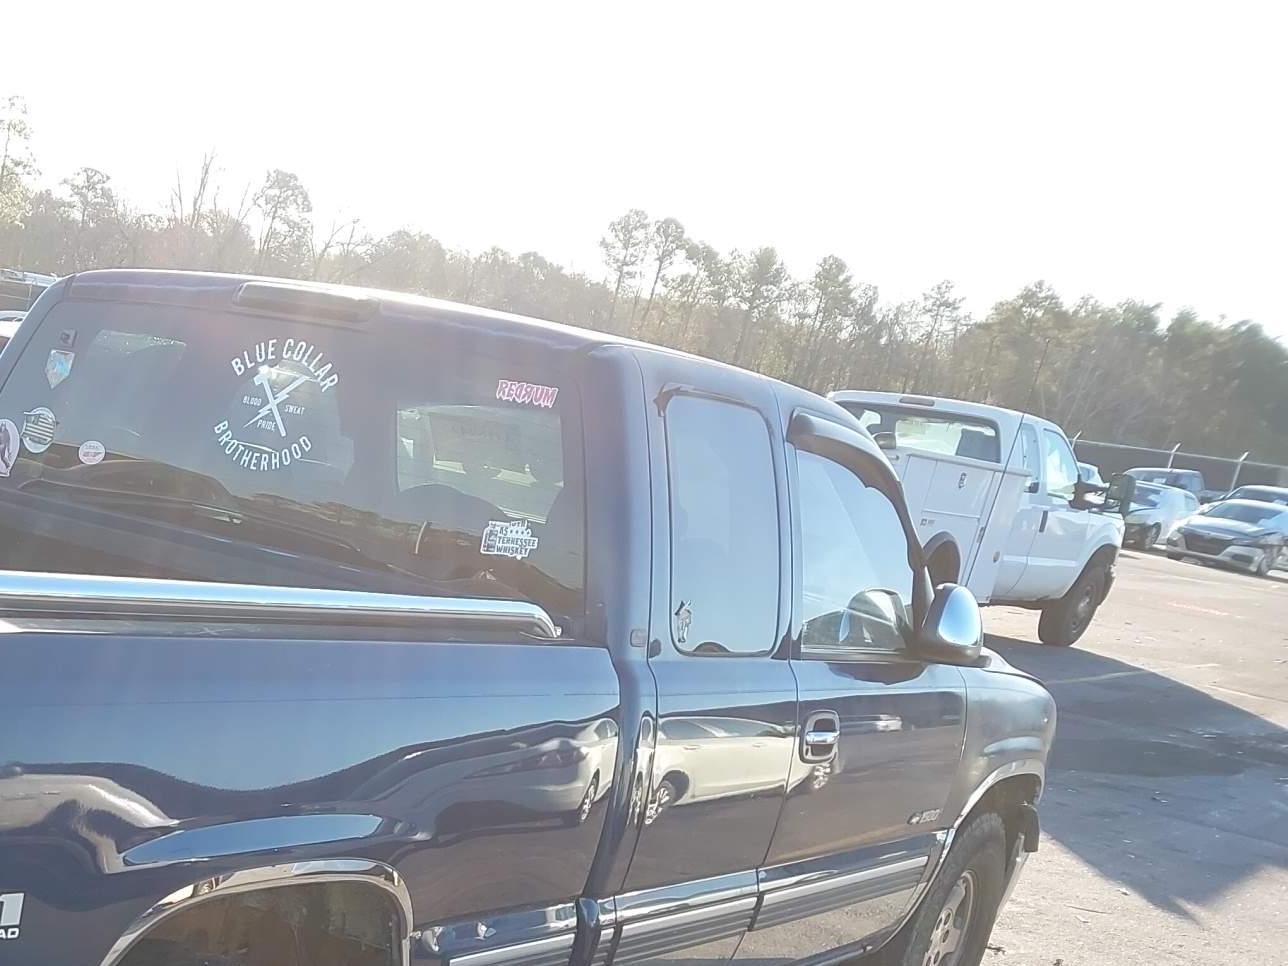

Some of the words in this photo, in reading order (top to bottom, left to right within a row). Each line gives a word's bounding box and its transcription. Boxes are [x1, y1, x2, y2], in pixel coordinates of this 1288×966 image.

[231, 339, 277, 376] BLUE
[282, 339, 339, 393] COLLAR
[242, 395, 262, 406] BLOOD
[285, 404, 305, 415] SWEAT
[257, 419, 277, 431] PRIDE
[214, 420, 312, 471] BROTHERHOOD
[497, 536, 537, 547] TENNESSEE
